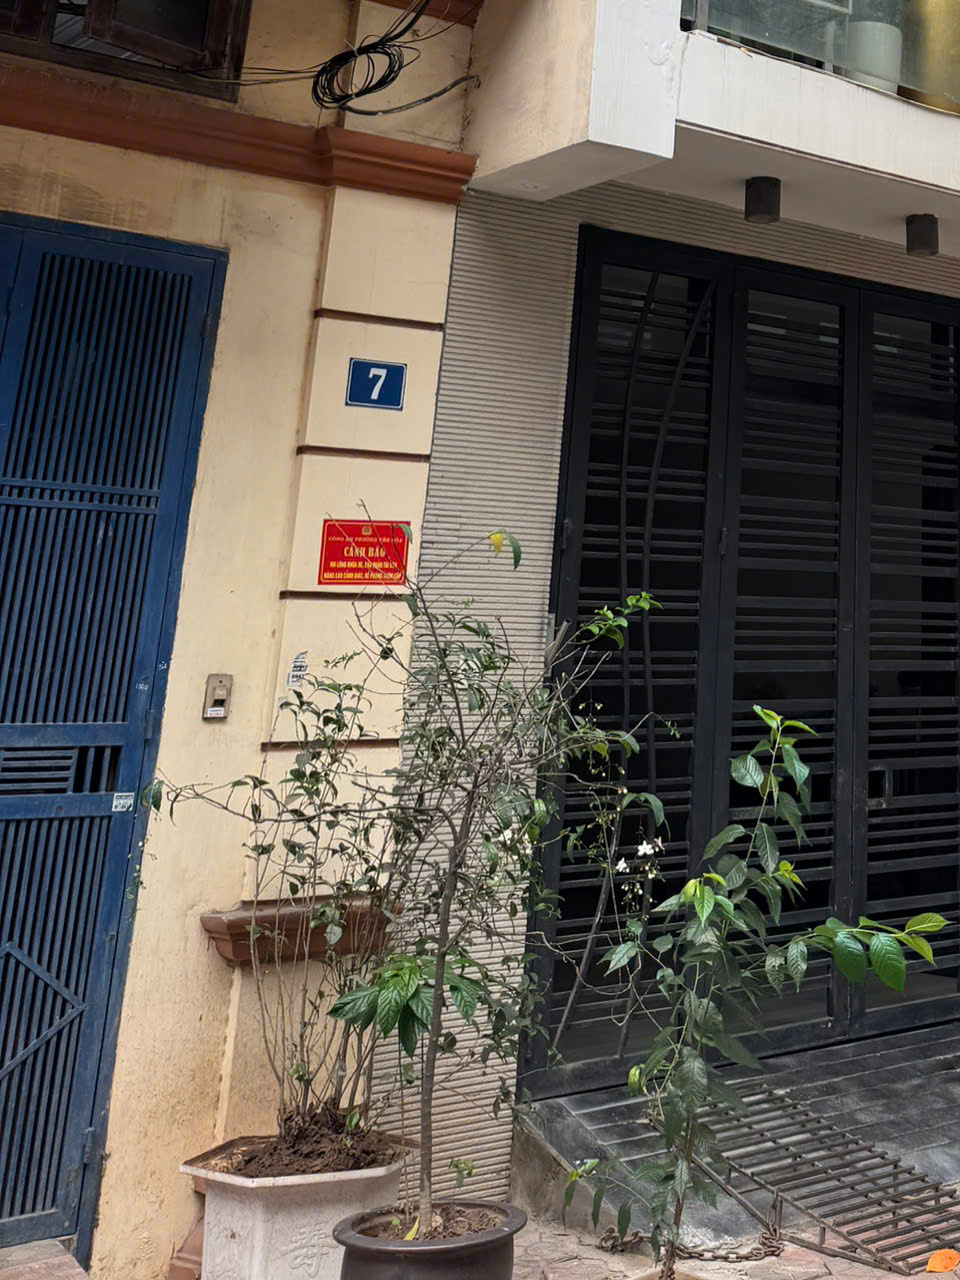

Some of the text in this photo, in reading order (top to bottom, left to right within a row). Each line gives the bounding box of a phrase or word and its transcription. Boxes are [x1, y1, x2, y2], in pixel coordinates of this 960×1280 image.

[369, 367, 387, 400] 7
[344, 545, 386, 558] CẢNH BÁO
